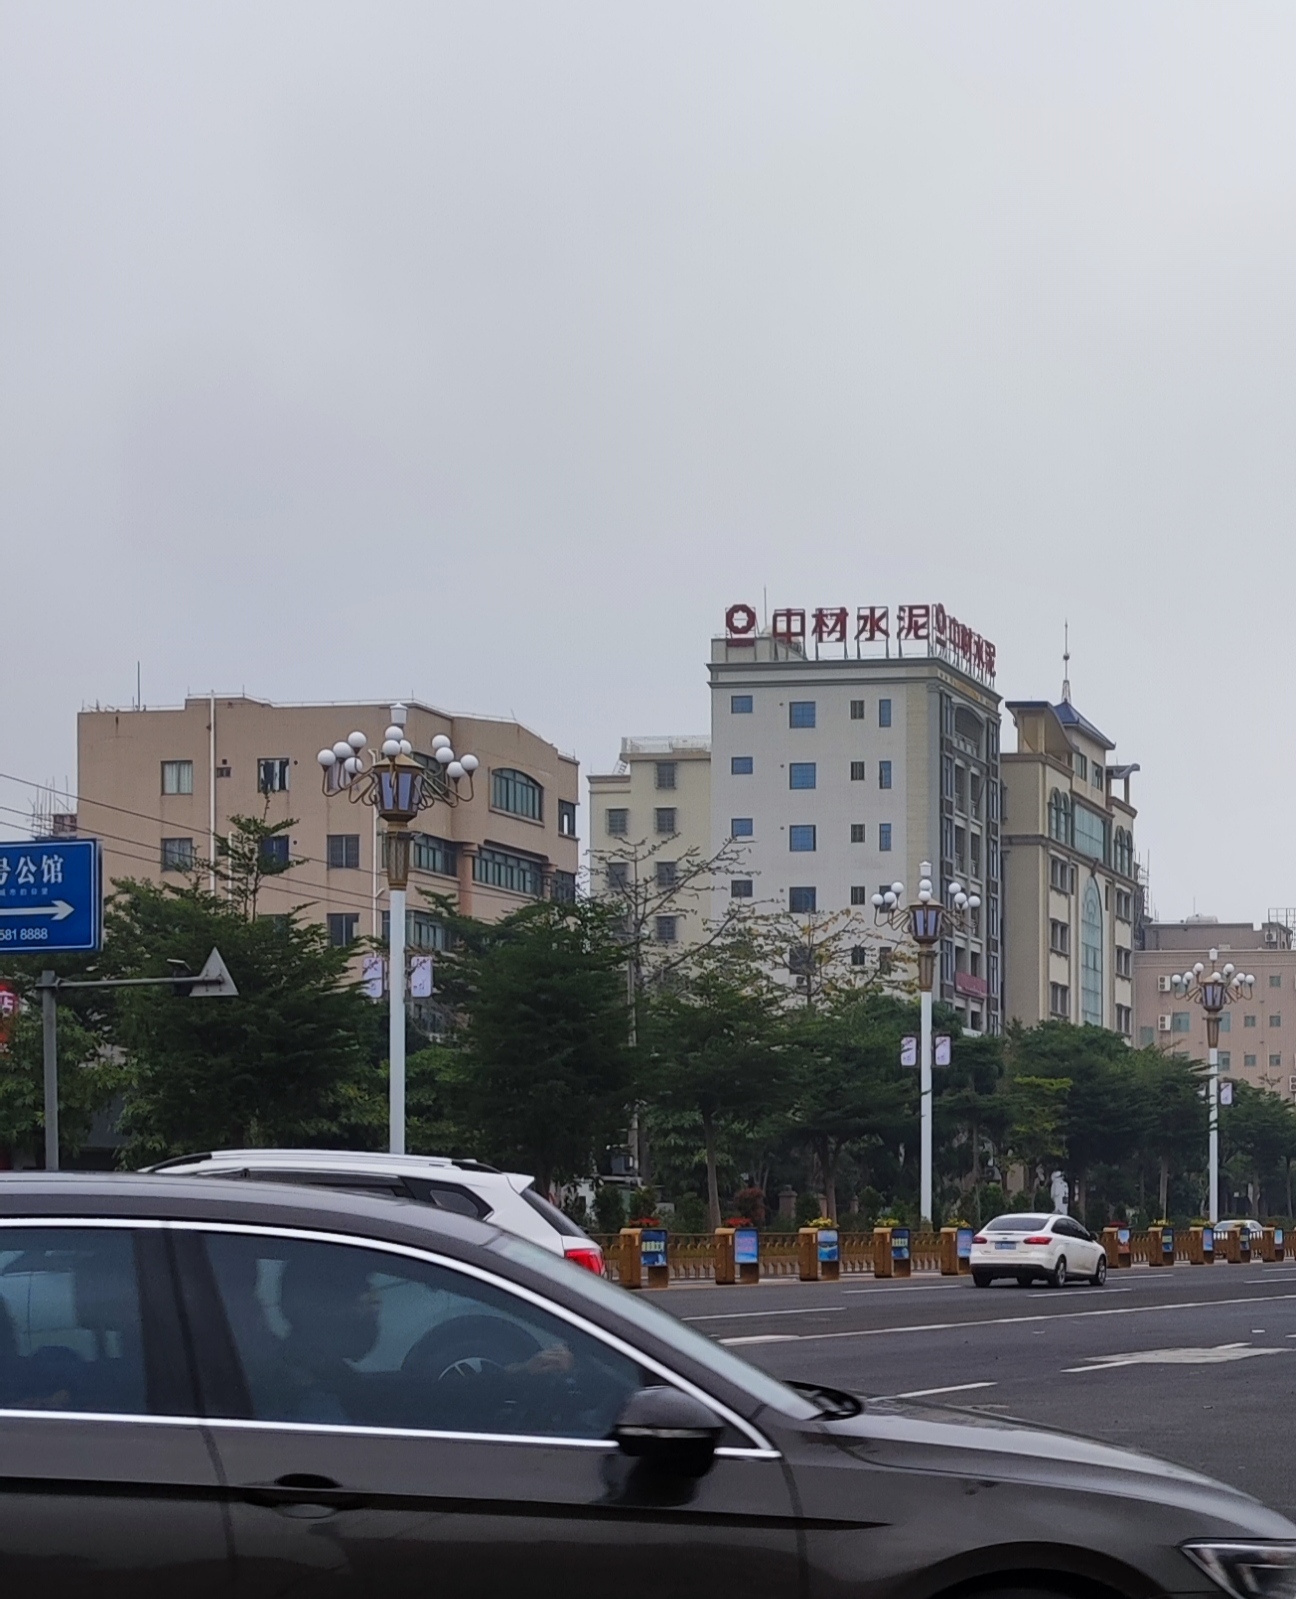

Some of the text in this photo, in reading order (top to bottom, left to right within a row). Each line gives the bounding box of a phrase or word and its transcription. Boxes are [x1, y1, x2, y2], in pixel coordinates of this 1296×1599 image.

[772, 604, 930, 645] 中材水泥
[20, 927, 48, 940] 8888
